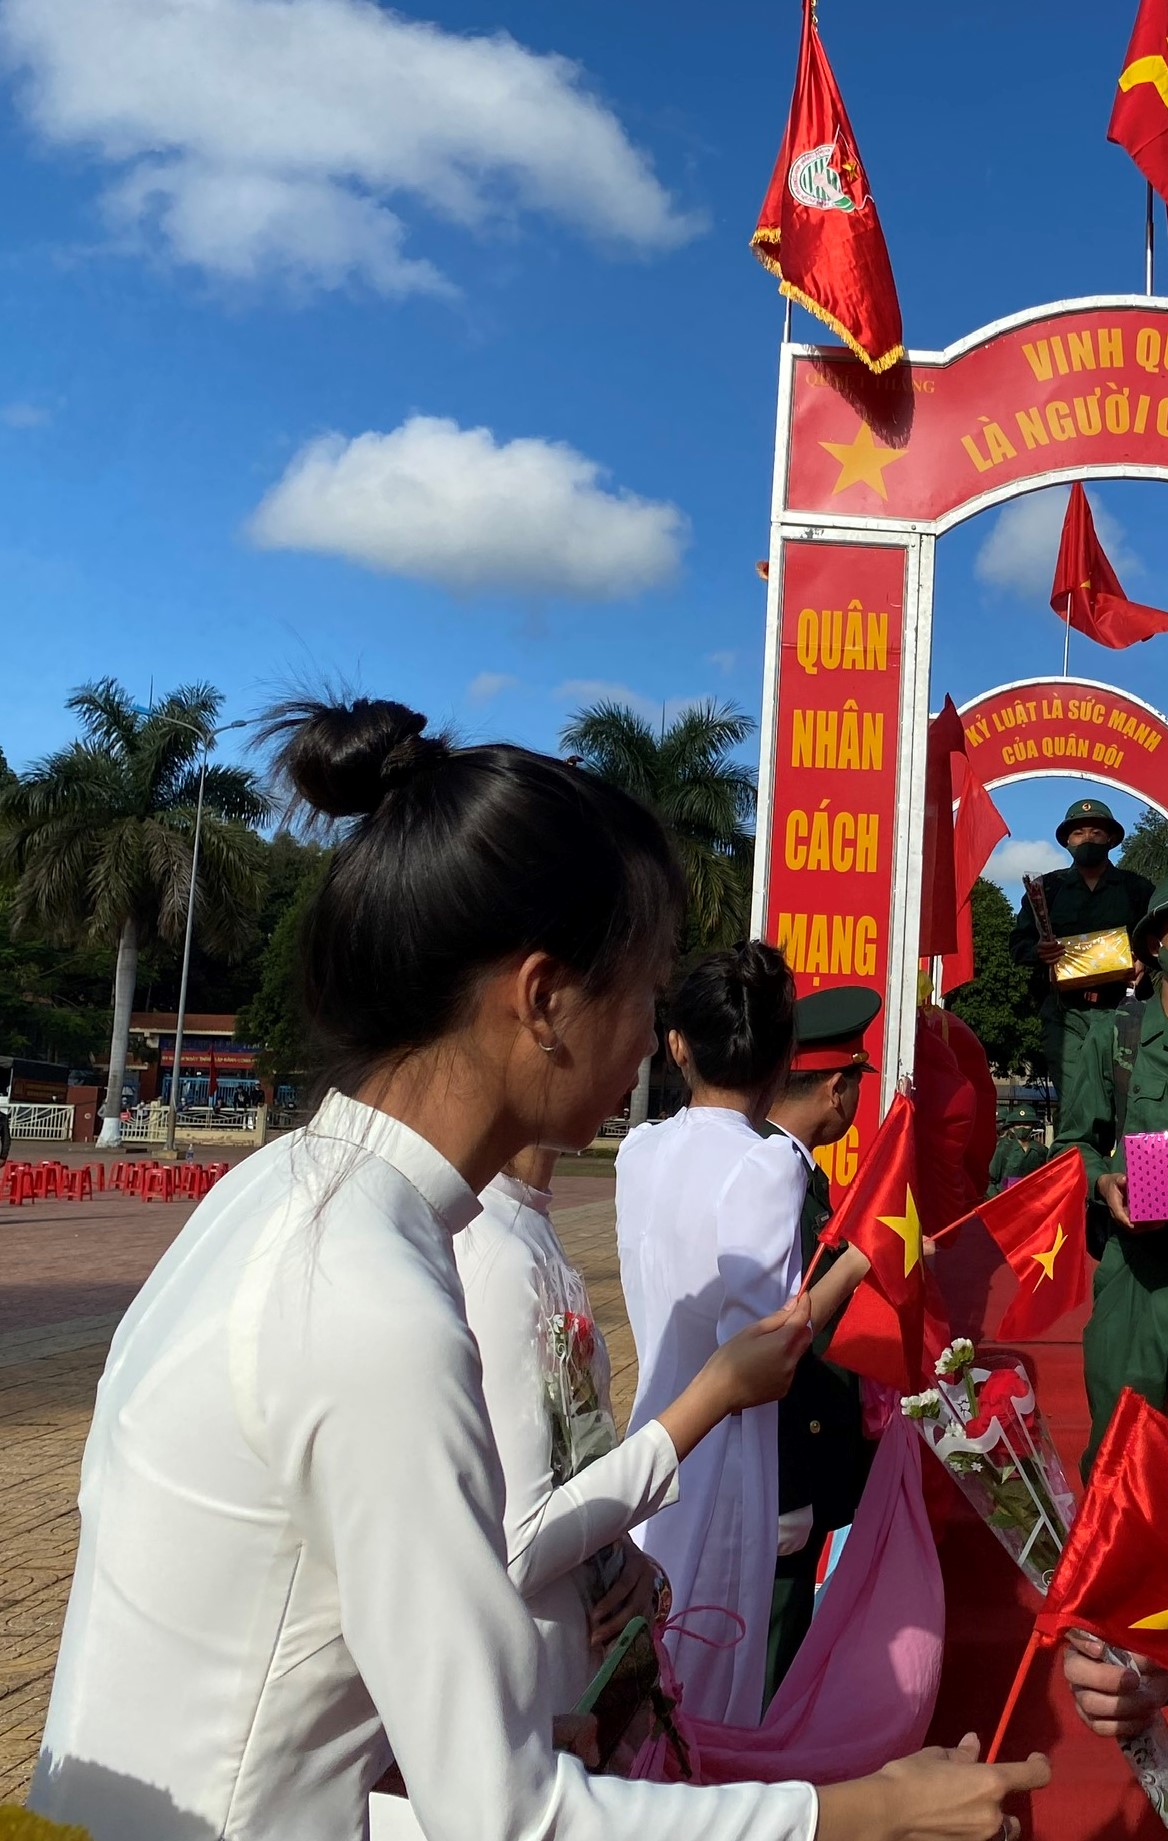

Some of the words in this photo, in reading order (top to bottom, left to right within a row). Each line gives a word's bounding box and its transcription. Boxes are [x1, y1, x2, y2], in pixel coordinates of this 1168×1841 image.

[1021, 328, 1124, 382] VINH
[961, 415, 1017, 473] LÀ
[1015, 381, 1150, 450] NGƯỜI
[797, 599, 888, 674] QUÂN
[792, 699, 883, 770] NHÂN
[965, 713, 991, 748] KỶ
[992, 700, 1037, 728] LUẬT
[1042, 692, 1064, 720] LÀ
[1068, 696, 1105, 724] SỨC
[1108, 709, 1162, 753] MẠNH
[1002, 735, 1038, 765] CỦA
[1042, 733, 1089, 759] QUÂN
[1092, 743, 1124, 769] ĐỘI
[785, 799, 879, 872] CÁCH
[778, 913, 877, 986] MẠNG
